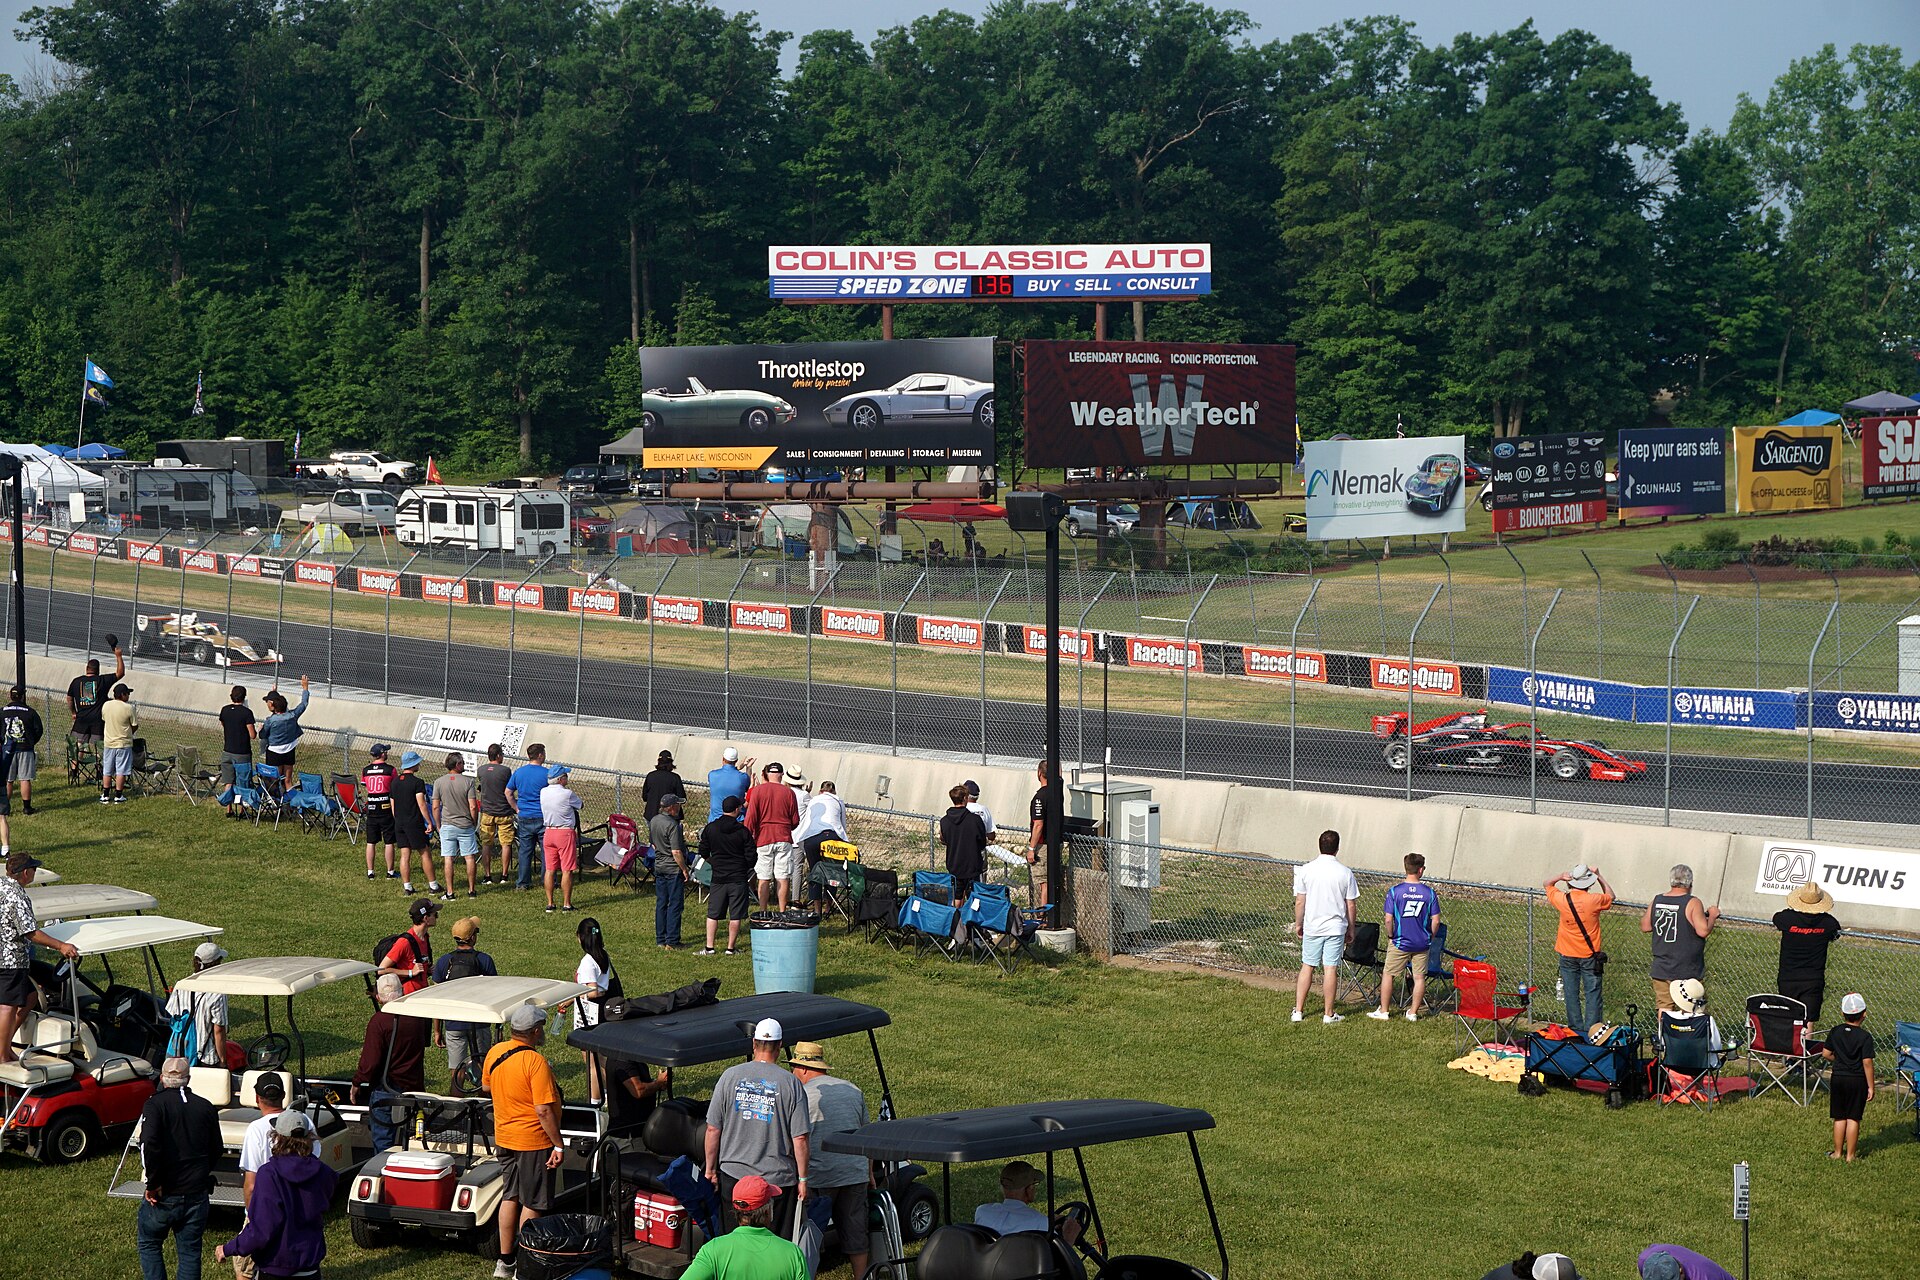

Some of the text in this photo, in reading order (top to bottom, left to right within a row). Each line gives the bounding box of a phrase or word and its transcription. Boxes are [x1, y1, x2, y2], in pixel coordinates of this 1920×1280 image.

[776, 249, 1204, 271] COLIN'S CLASSIC AUTO
[838, 278, 967, 294] SPEED ZONE
[978, 275, 1011, 294] 136
[1027, 277, 1199, 291] BUY SELL CONSULT
[1069, 352, 1258, 365] LEGENDARY RACING. ICONIC PROTECTION.
[758, 359, 865, 381] Throttlestop
[792, 378, 851, 390] driven by passion
[653, 453, 752, 462] ELKHART LAKE, WISCONSIN
[812, 450, 862, 458] CONSIGNMENT
[1624, 438, 1721, 462] Keep your ears safe.
[1760, 440, 1823, 466] SARGENTO
[1331, 467, 1404, 496] Nemak
[1494, 470, 1512, 483] Jeep
[1518, 470, 1530, 479] KIA
[1879, 465, 1904, 483] POWER
[1636, 482, 1681, 495] SOUNHAUS
[1760, 488, 1785, 497] OFFICIAL
[1786, 487, 1807, 496] CHEESE
[1333, 499, 1404, 510] Innovative Lightweighting
[1520, 504, 1584, 528] BOUCHER.COM
[298, 565, 333, 583] RaceQuip
[426, 580, 464, 598] RaceQuip
[498, 585, 540, 605] RaceQuip
[572, 592, 616, 611] RaceQuip
[653, 600, 699, 621] RaceQuip
[736, 607, 786, 629] RaceQuip
[827, 612, 880, 635] RaceQuip
[922, 621, 978, 644] RaceQuip
[1133, 642, 1197, 667] RaceQup
[1250, 651, 1320, 678] RaceQuip
[1378, 664, 1455, 691] RaceQuip
[1539, 680, 1595, 704] YAMAHA
[1528, 696, 1591, 710] ACING
[1692, 694, 1755, 715] YAMAHA
[1856, 700, 1920, 721] YAMAHA
[1681, 713, 1750, 721] RACING
[1844, 719, 1919, 728] RACING
[440, 727, 477, 744] TURN 5
[368, 776, 384, 793] 06
[826, 845, 849, 856] PACKERS
[1823, 864, 1906, 890] TURN 5
[1402, 900, 1425, 918] 51
[1788, 925, 1825, 935] Snap-on
